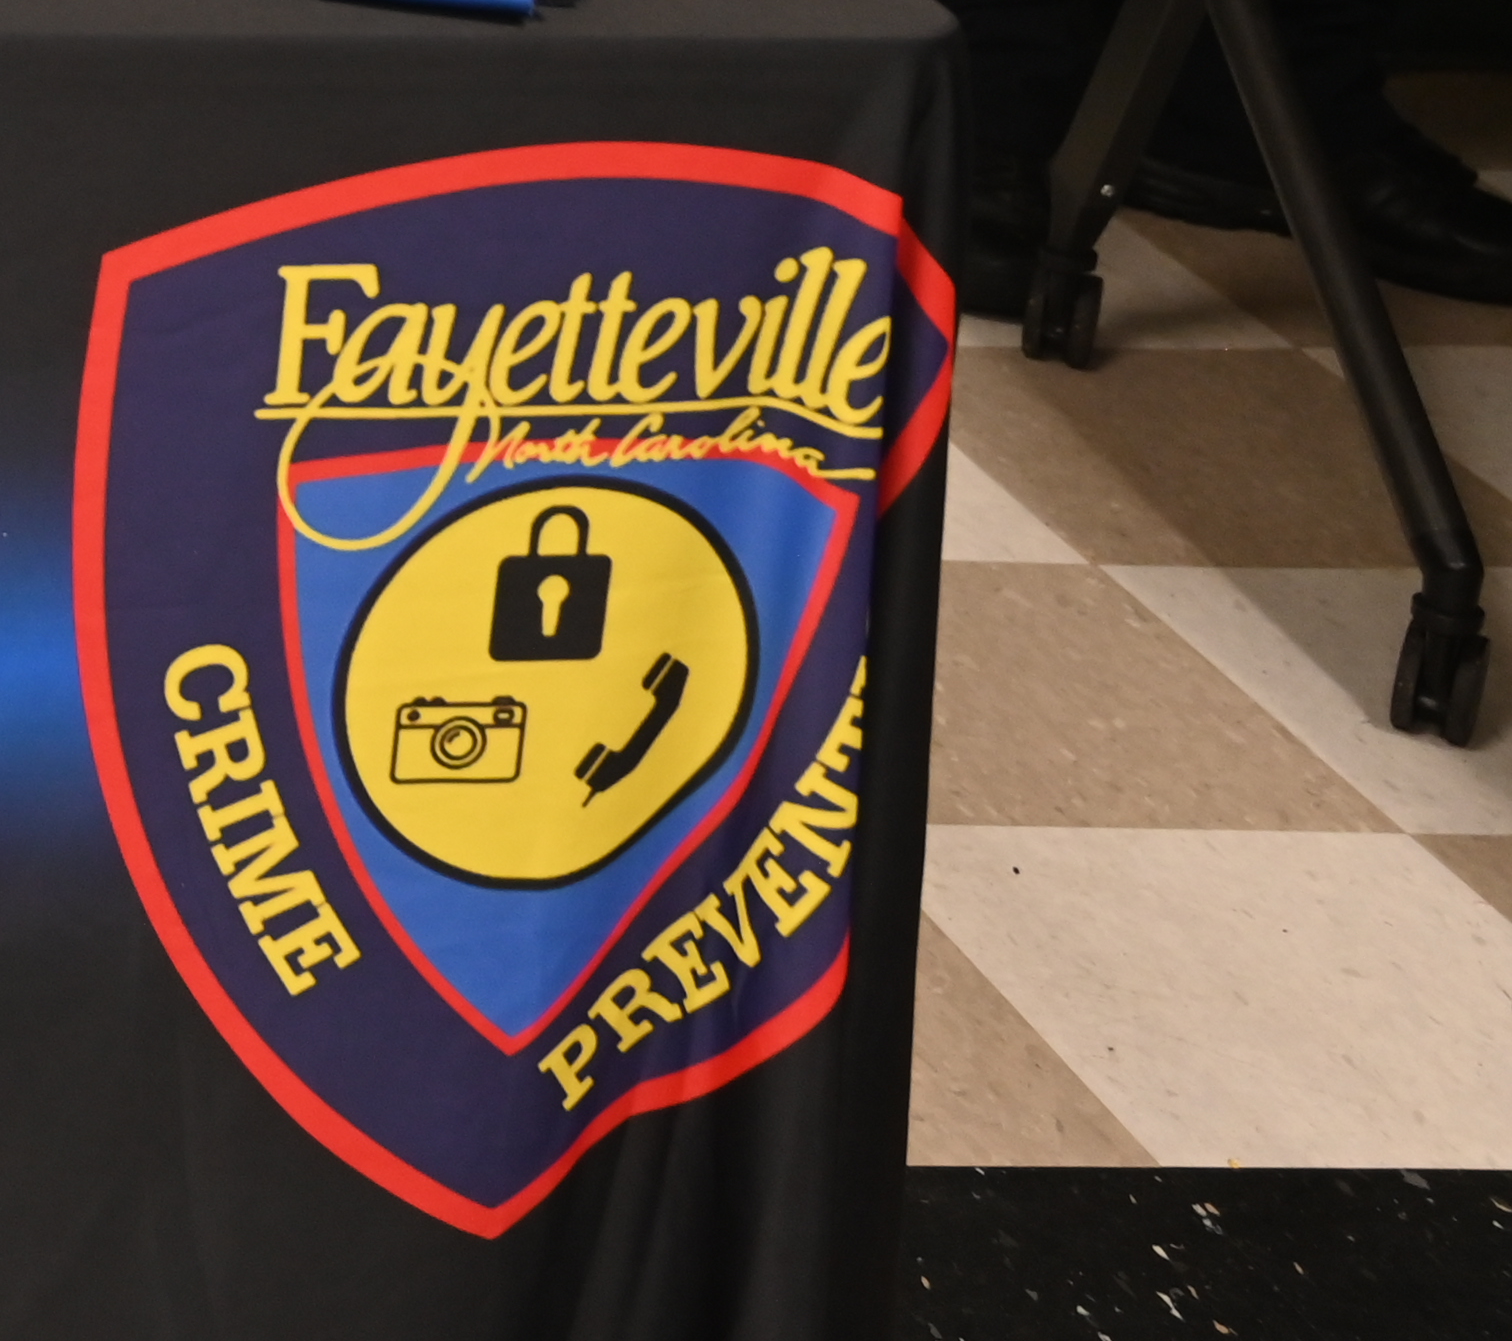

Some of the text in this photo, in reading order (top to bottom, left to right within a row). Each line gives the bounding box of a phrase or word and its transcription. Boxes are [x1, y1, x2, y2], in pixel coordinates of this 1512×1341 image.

[264, 246, 891, 551] Fayetteville
[466, 407, 876, 483] North Carolina
[162, 643, 360, 996] CRIME
